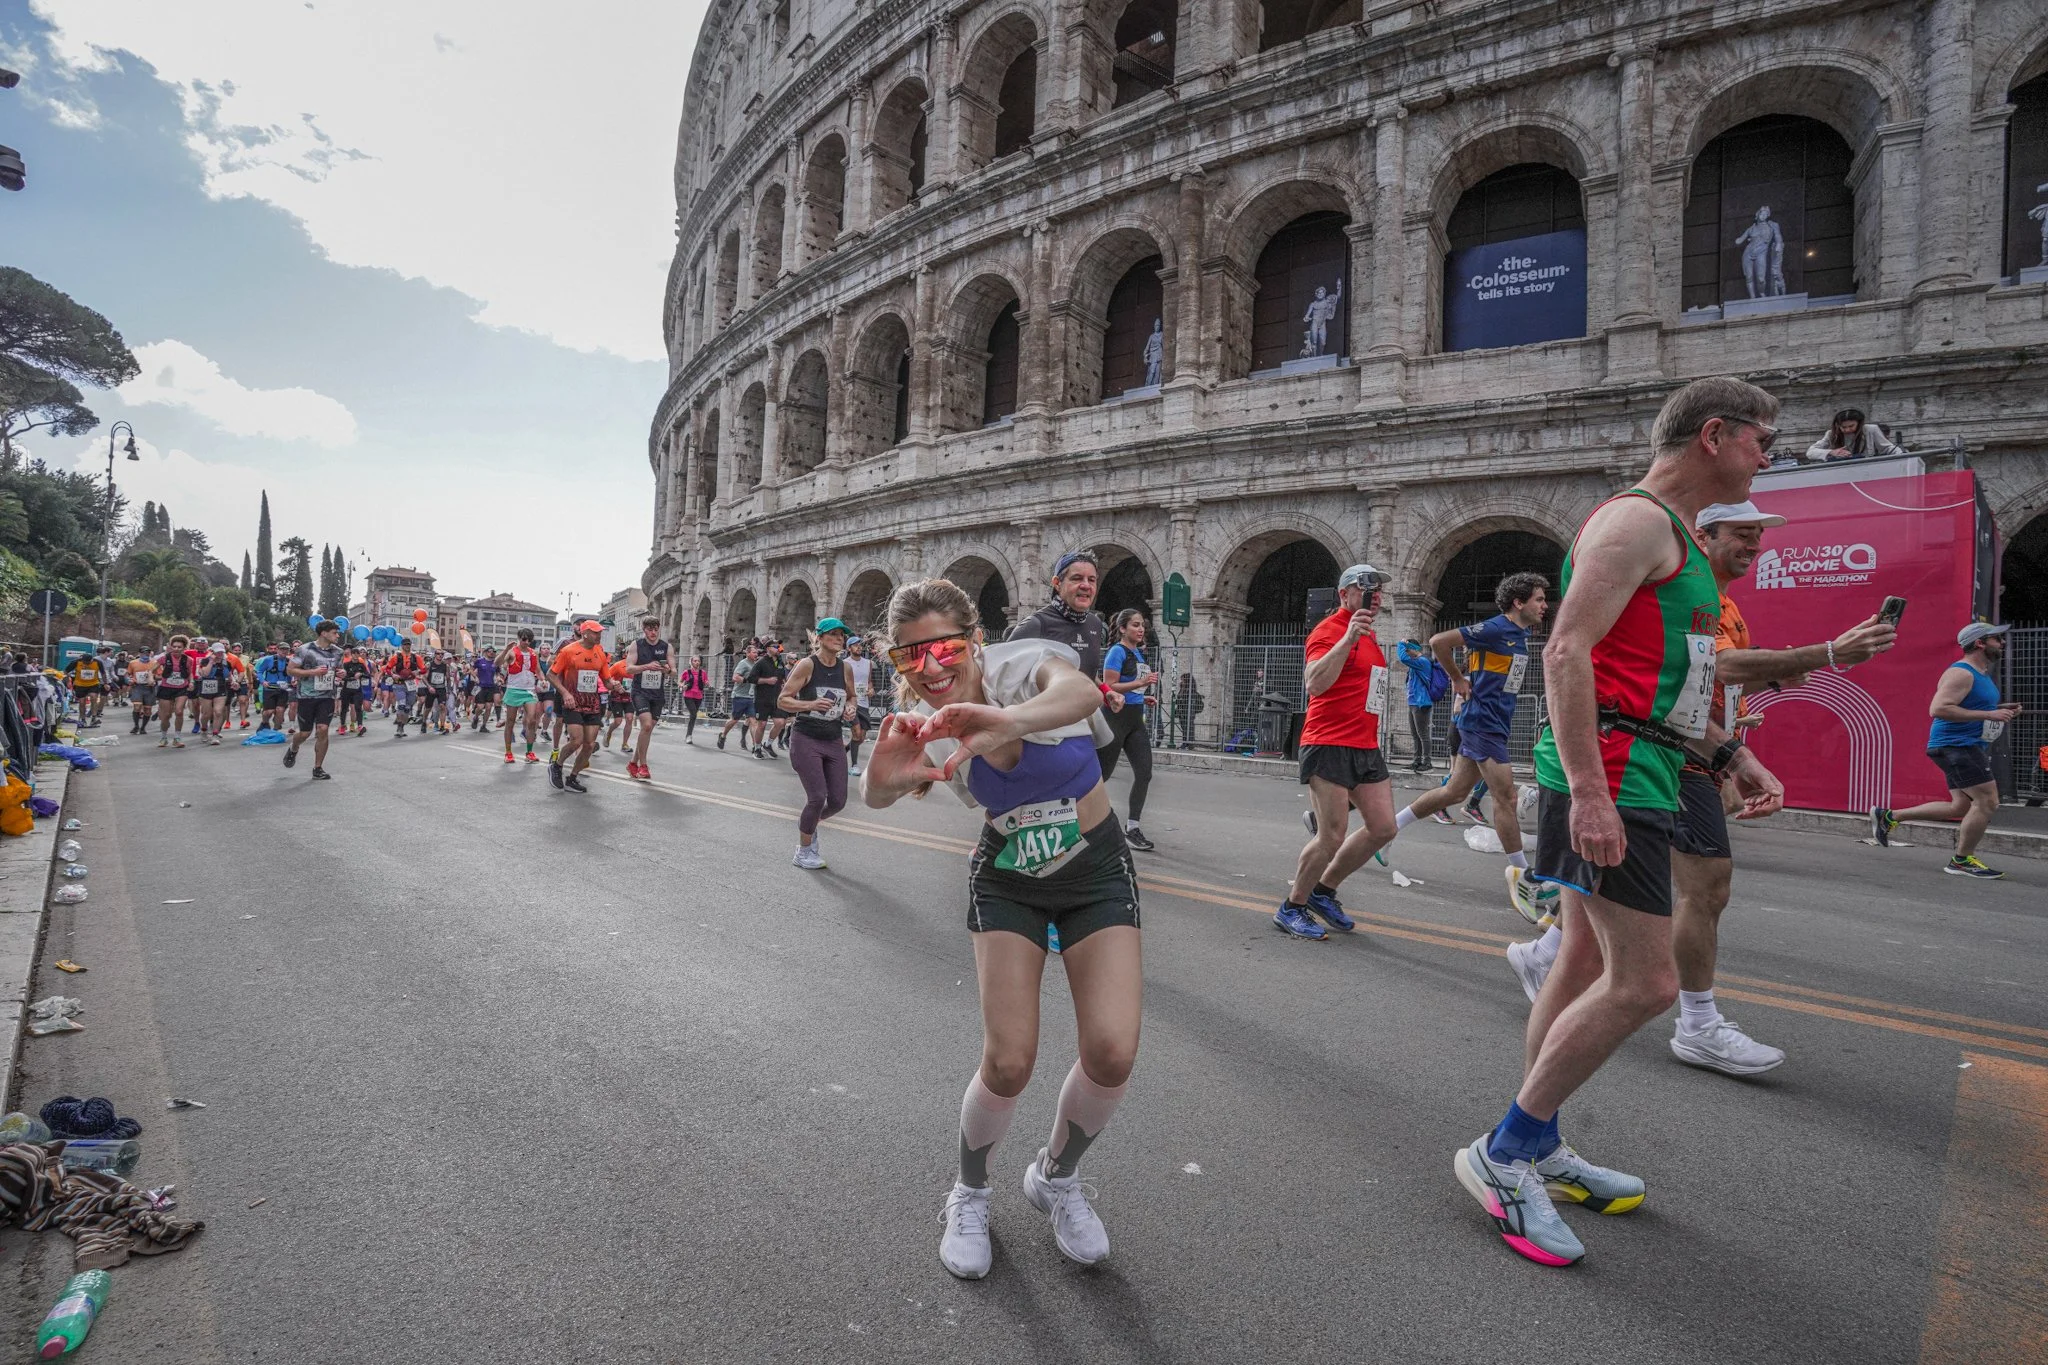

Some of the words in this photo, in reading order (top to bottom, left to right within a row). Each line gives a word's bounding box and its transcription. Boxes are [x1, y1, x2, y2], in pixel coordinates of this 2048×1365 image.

[1477, 288, 1504, 301] tells
[1505, 286, 1521, 297] its
[1523, 281, 1556, 294] story
[1788, 559, 1841, 573] ROME
[1813, 575, 1868, 583] MARATHON
[1690, 710, 1699, 724] 5
